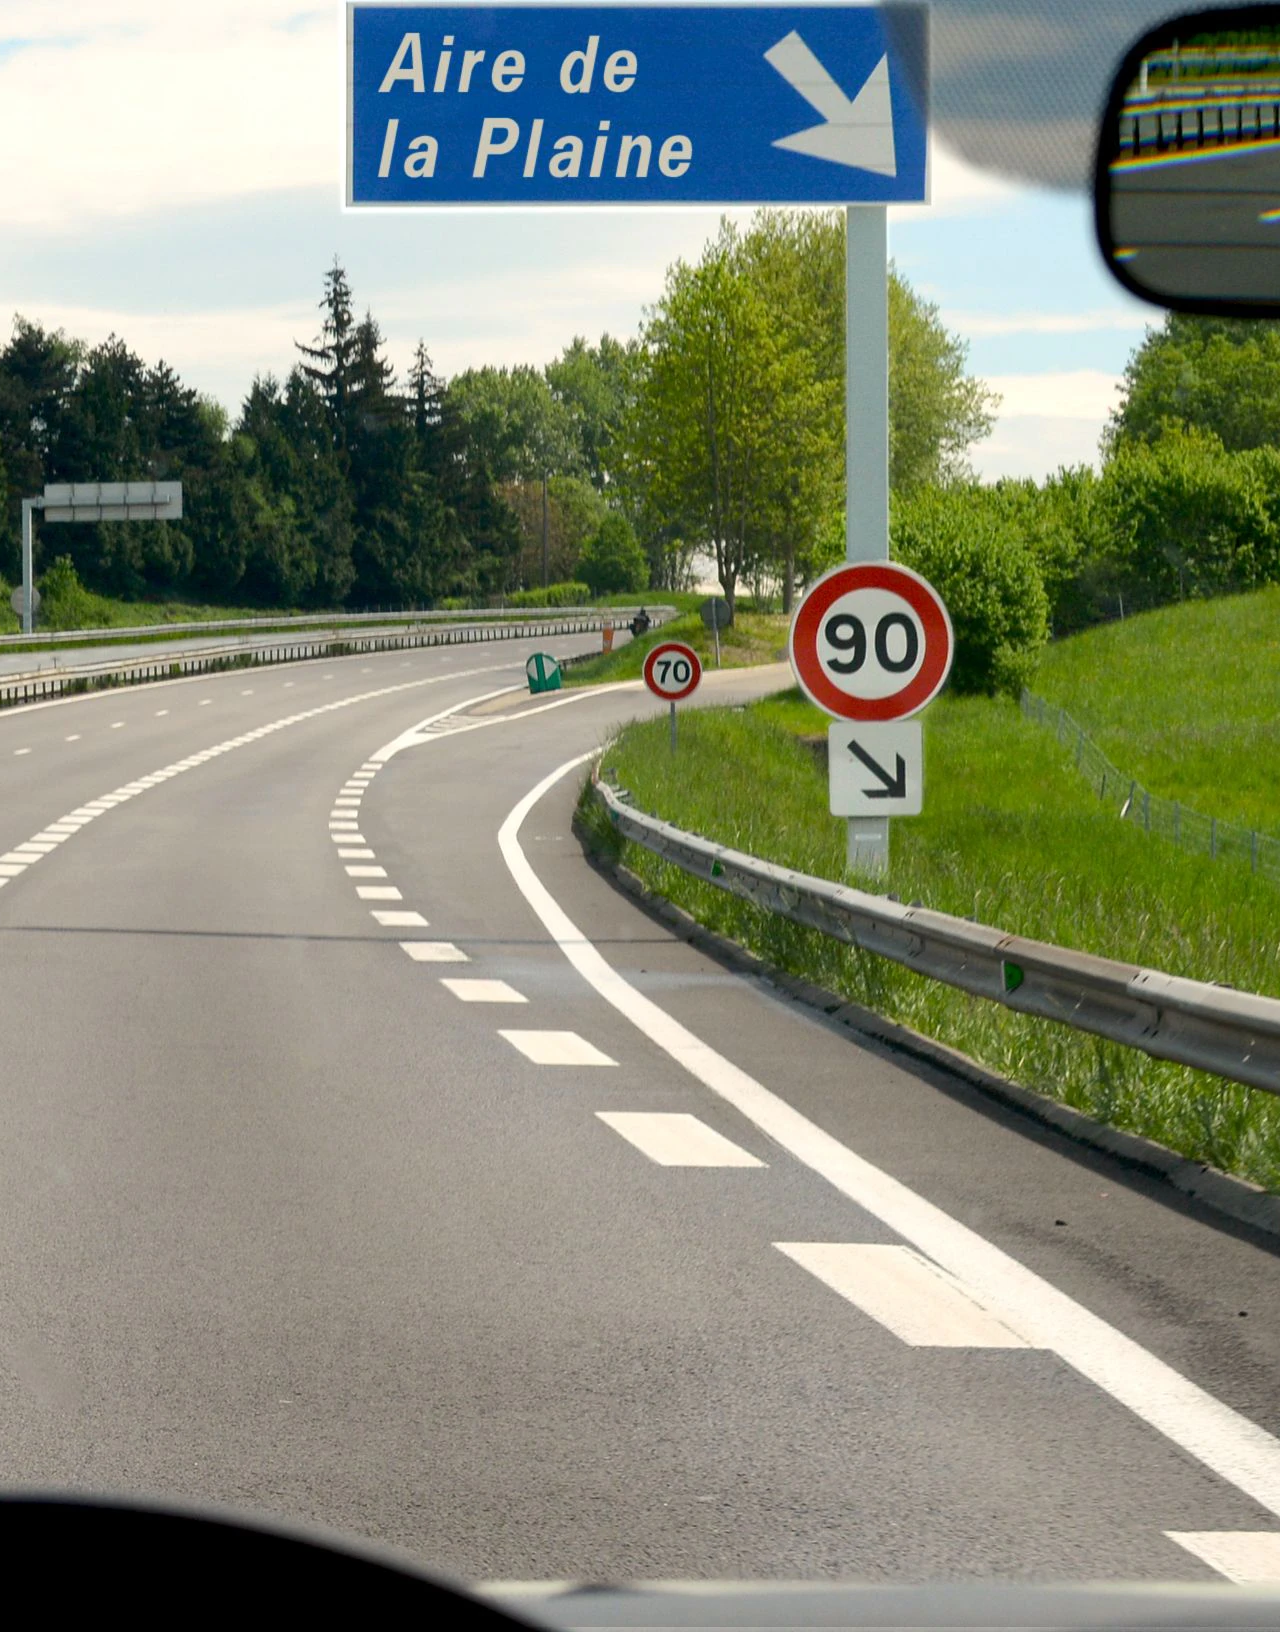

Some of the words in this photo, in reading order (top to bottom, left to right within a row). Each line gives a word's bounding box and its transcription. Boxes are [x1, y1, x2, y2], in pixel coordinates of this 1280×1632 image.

[378, 32, 526, 93] Aire
[559, 35, 638, 94] de
[377, 118, 439, 178] la
[472, 117, 693, 178] Plaine
[656, 660, 690, 684] 70
[825, 612, 919, 674] 90
